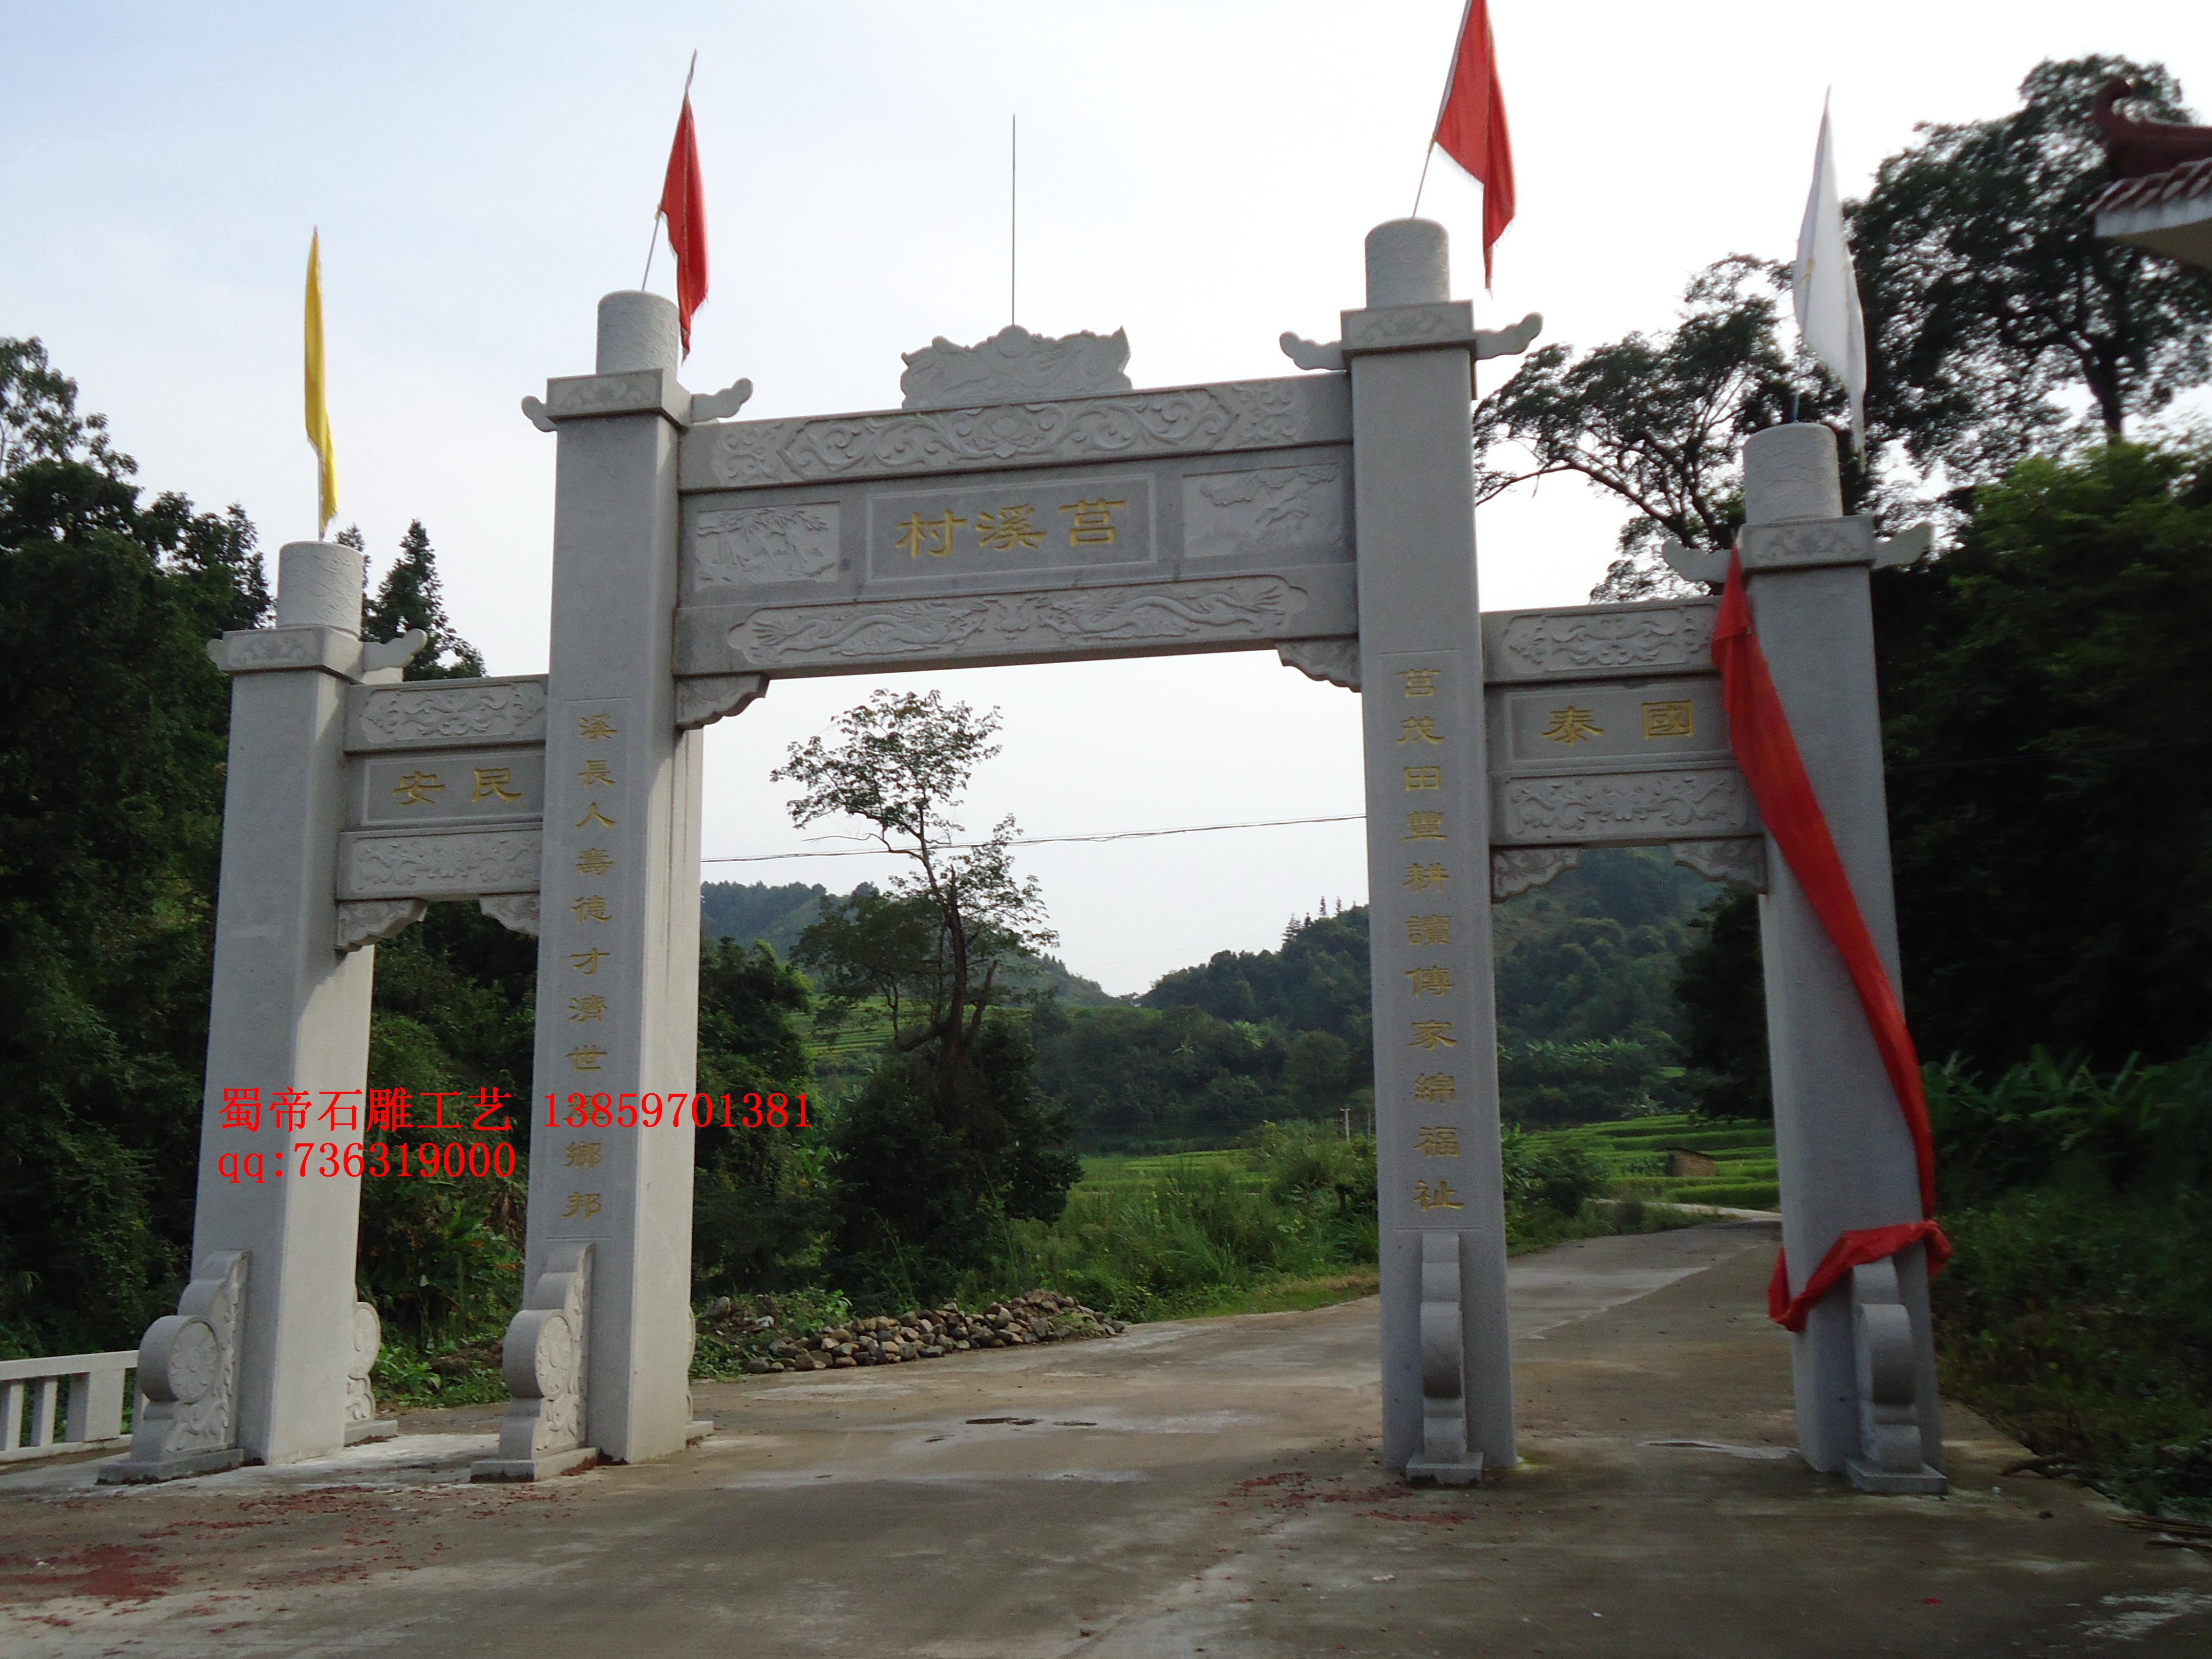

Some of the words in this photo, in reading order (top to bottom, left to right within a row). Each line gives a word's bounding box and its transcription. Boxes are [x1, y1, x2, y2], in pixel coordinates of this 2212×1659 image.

[895, 499, 1128, 559] 莒溪村
[1541, 699, 1696, 747] 國泰
[391, 767, 523, 806] 民安
